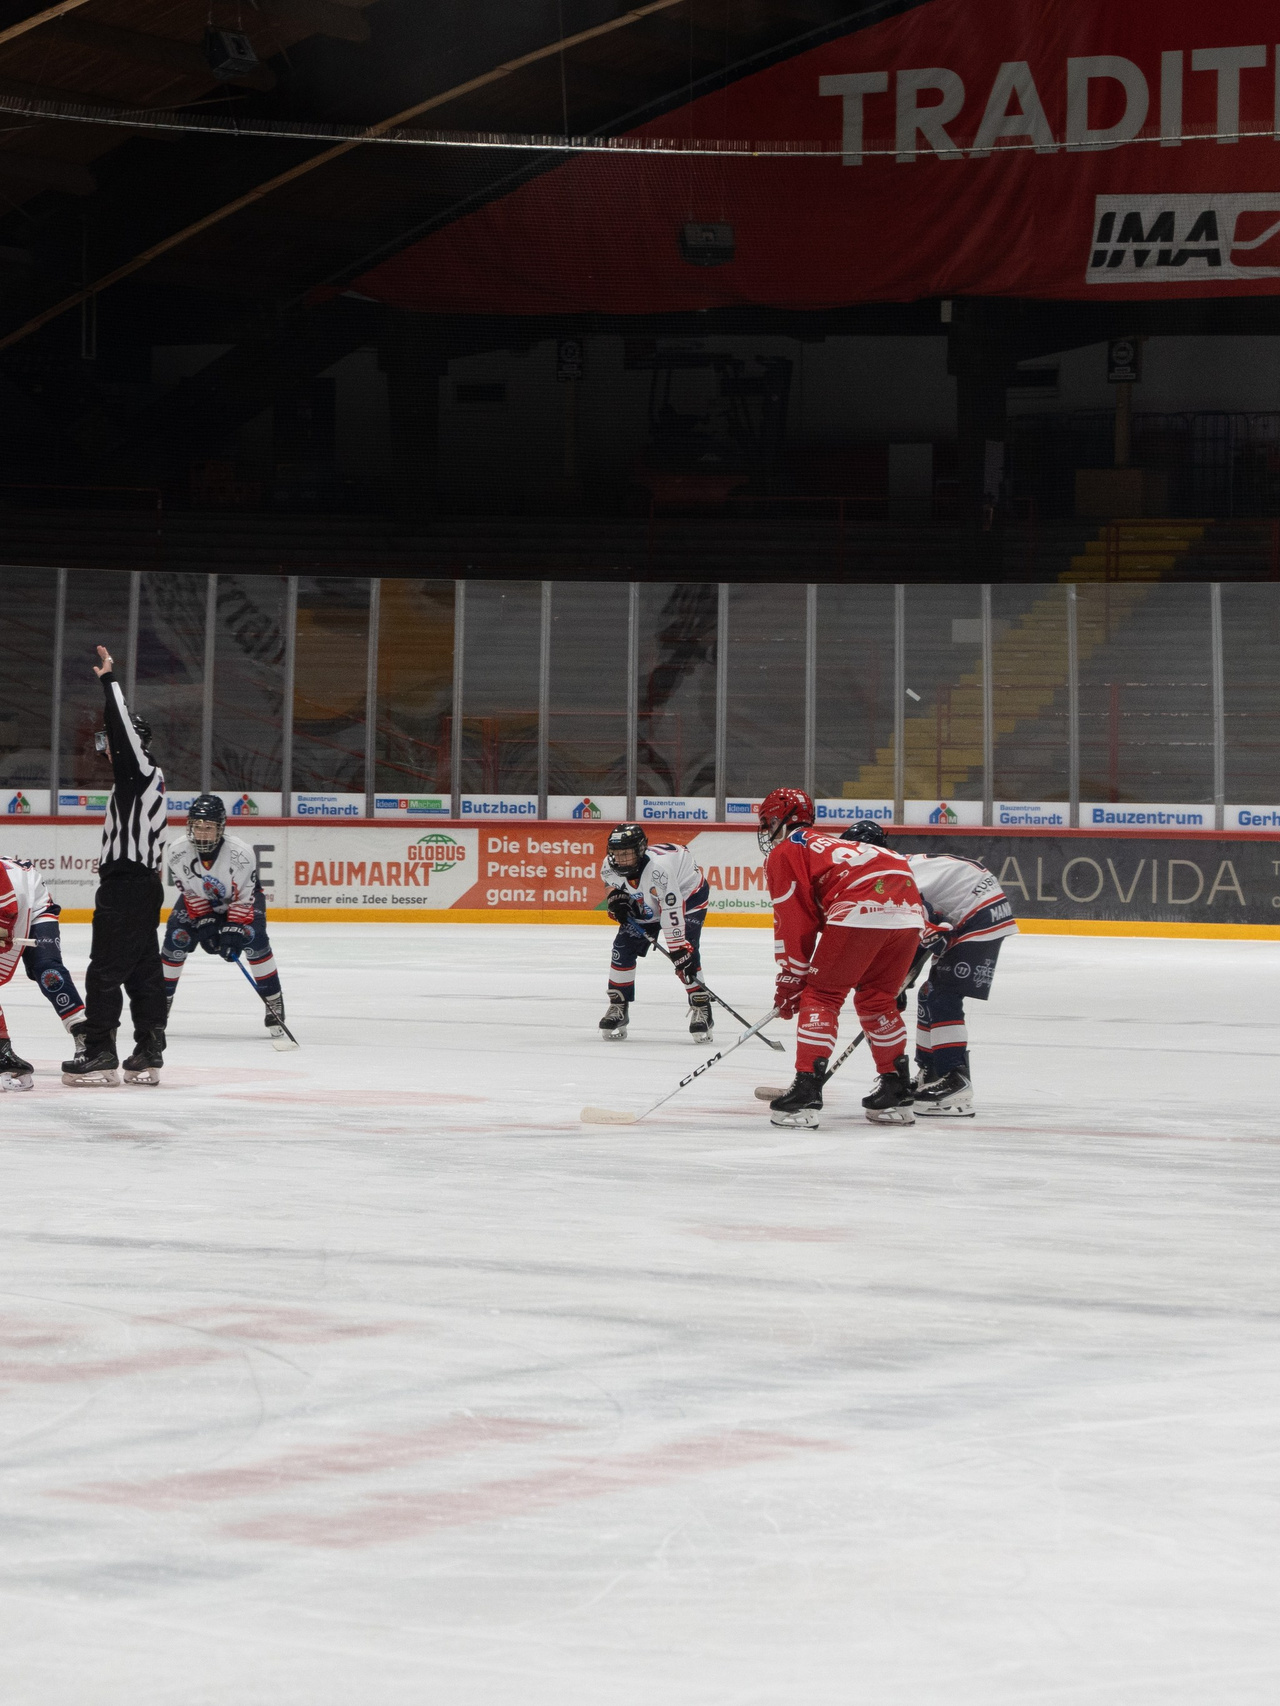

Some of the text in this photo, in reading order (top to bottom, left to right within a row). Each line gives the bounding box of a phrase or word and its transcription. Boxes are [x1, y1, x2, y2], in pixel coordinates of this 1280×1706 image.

[819, 43, 1280, 167] TRADIT
[297, 803, 359, 816] Gerhardt
[377, 799, 397, 808] ideen
[410, 800, 441, 809] Machen
[461, 800, 536, 814] Butzbach
[643, 799, 685, 807] Bauzentrum
[1000, 804, 1041, 812] Bauzentrum
[642, 807, 708, 820] Gerhardt
[816, 805, 892, 819] Butzbach
[999, 812, 1063, 826] Gerhardt
[1092, 808, 1203, 826] Bauzentrum
[408, 845, 466, 861] GLOBUS
[487, 837, 594, 856] Die besten
[60, 855, 98, 874] Morg
[487, 861, 596, 879] Preise sind
[294, 861, 434, 887] BAUMARKT
[294, 894, 428, 905] Immer eine Idee besser
[486, 887, 587, 906] ganz nah!
[669, 911, 679, 927] 5
[679, 1052, 722, 1087] CCM
